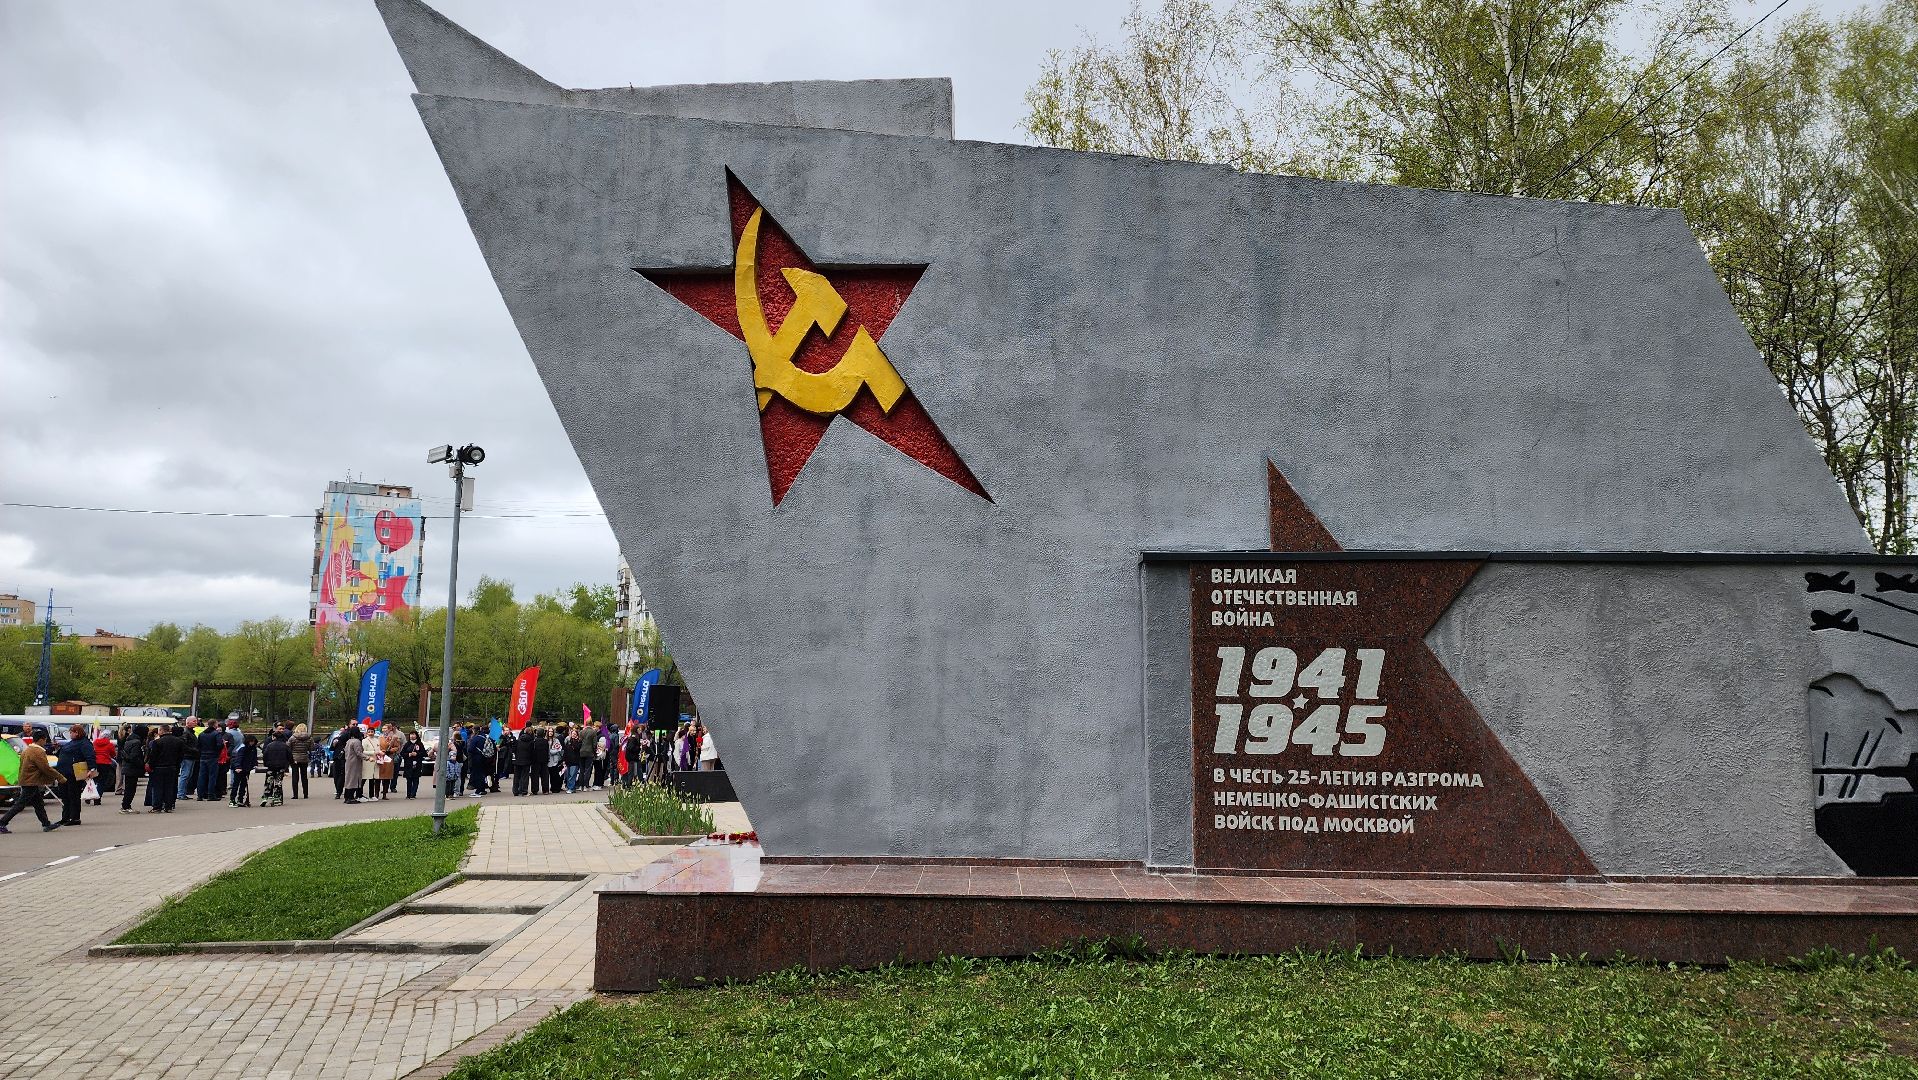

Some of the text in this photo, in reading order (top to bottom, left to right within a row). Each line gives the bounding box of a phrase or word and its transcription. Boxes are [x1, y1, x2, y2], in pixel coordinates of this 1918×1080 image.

[1211, 568, 1297, 584] ВЕЛИКАЯ
[1211, 589, 1358, 606] ОТЕЧЕСТВЕННАЯ
[1211, 607, 1275, 627] ВОЙНА
[1215, 646, 1386, 699] 1941
[1213, 703, 1388, 757] 1945
[1213, 767, 1485, 788] В ЧЕСТЬ 25-ЛЕТИЯ РАЗГРОМА
[1213, 791, 1438, 811] НЕМЕЦКО-ФАШИСТСКИХ
[1214, 810, 1415, 834] ВОЙСК ПОД МОСКВОЙ
